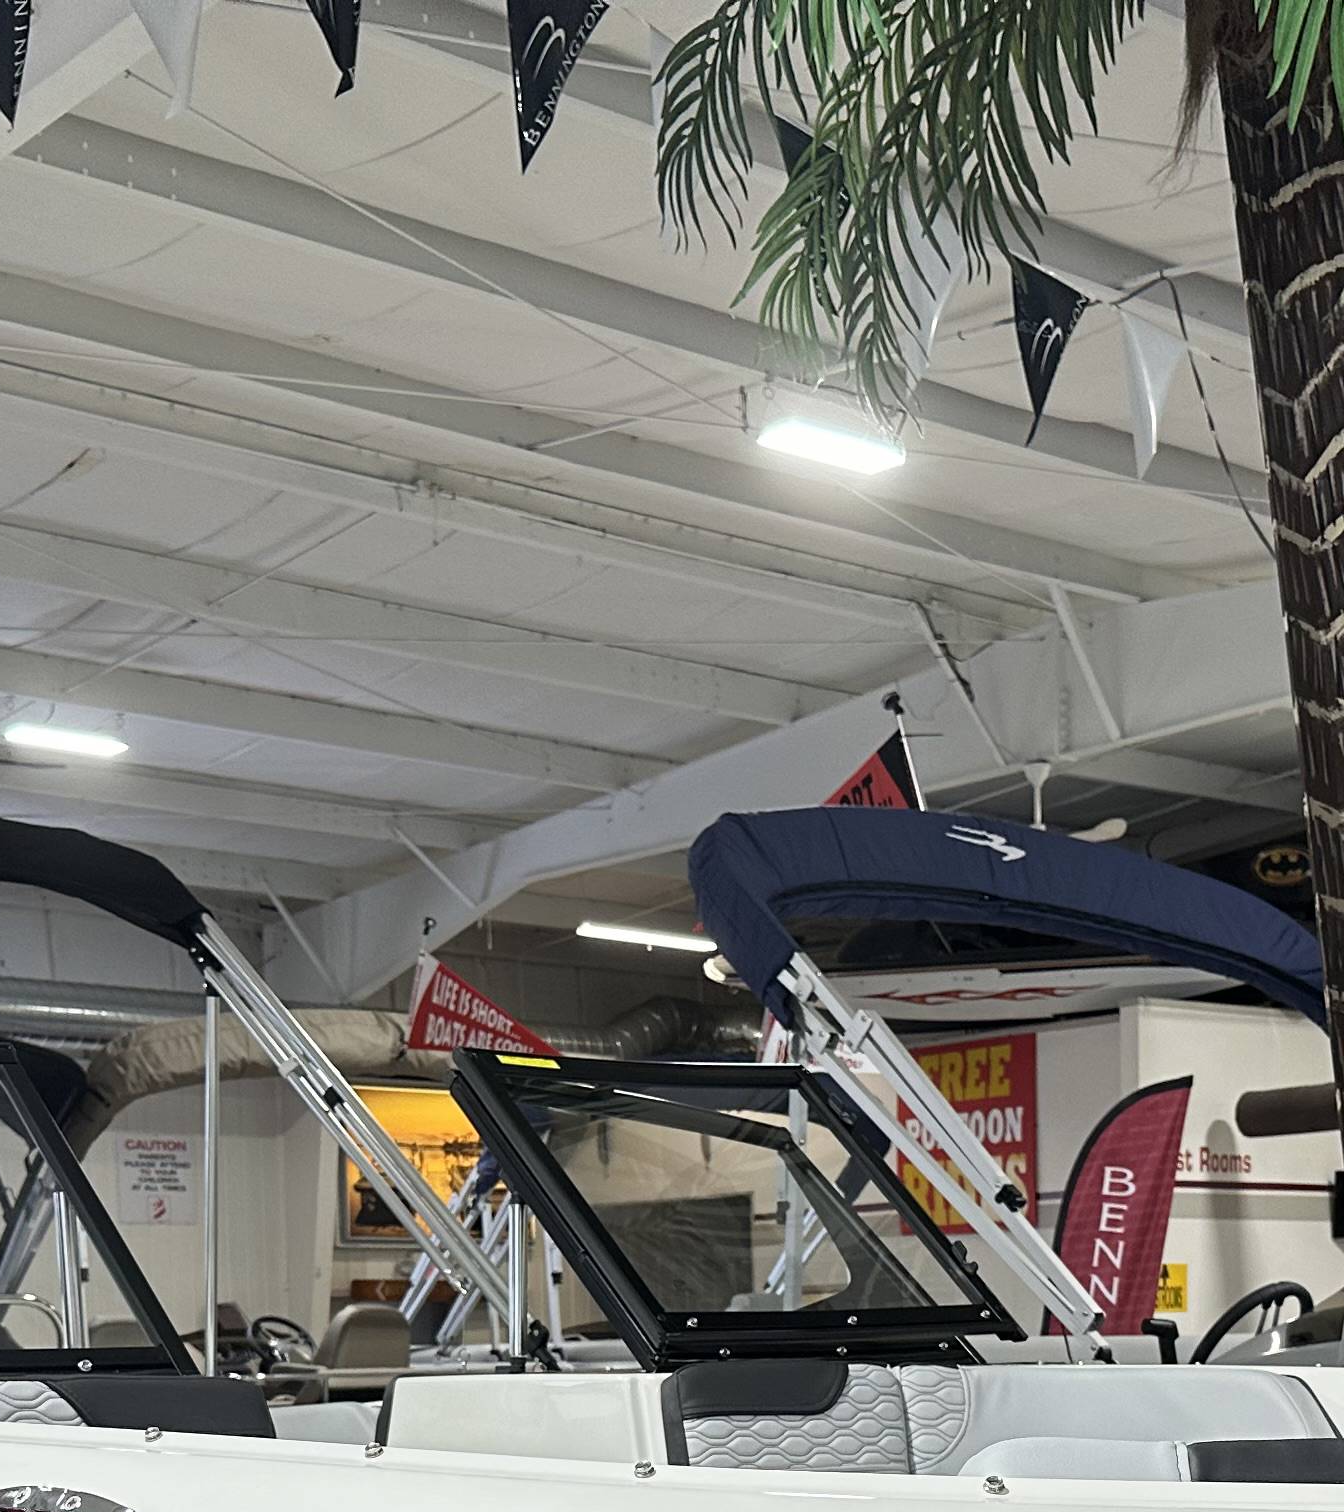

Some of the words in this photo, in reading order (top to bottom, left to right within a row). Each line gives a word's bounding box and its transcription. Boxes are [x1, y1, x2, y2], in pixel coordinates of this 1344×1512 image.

[432, 971, 459, 1011] LIFE
[458, 988, 472, 1016] IS
[424, 1013, 467, 1047] BOATS
[465, 1028, 494, 1050] ARE
[917, 1044, 1011, 1100] FREE
[125, 1139, 187, 1151] CAUTION
[1199, 1146, 1252, 1174] Rooms
[1089, 1166, 1136, 1306] BENN
